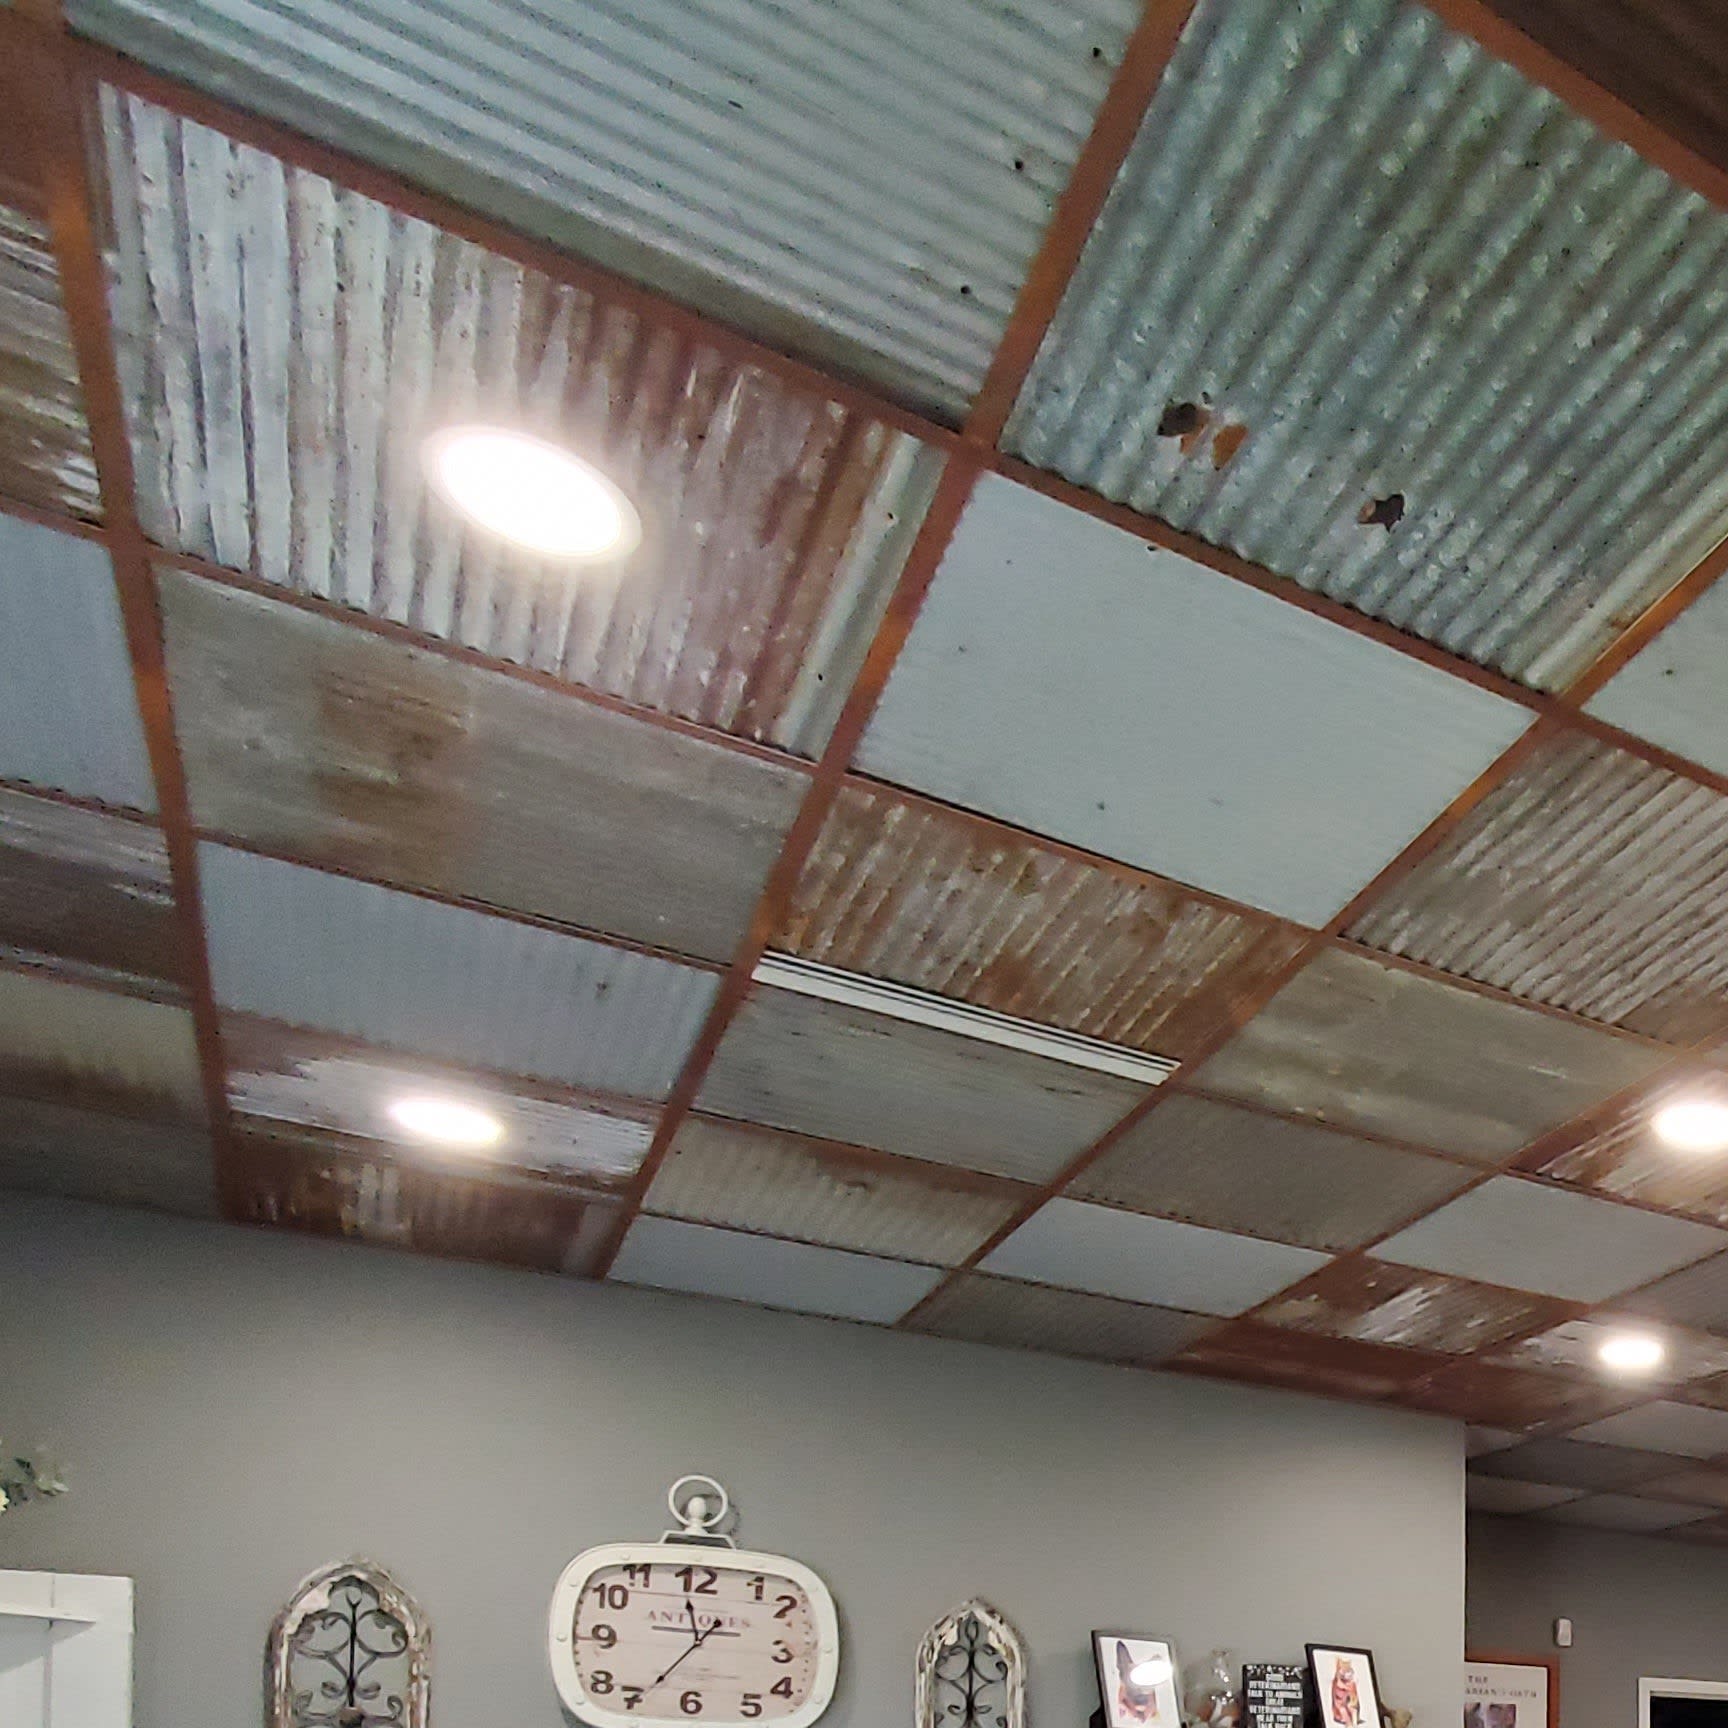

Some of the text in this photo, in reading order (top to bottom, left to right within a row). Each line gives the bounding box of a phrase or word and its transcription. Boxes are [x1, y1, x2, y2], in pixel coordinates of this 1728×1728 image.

[622, 1563, 652, 1588] 11
[675, 1566, 718, 1595] 12
[592, 1583, 629, 1610] 10
[746, 1576, 766, 1601] 1
[773, 1595, 798, 1619] 2
[590, 1624, 618, 1649] 9
[771, 1639, 794, 1664] 3
[590, 1670, 614, 1695] 8
[769, 1676, 794, 1699] 4
[621, 1686, 645, 1710] 7
[680, 1691, 703, 1714] 6
[740, 1693, 763, 1718] 5
